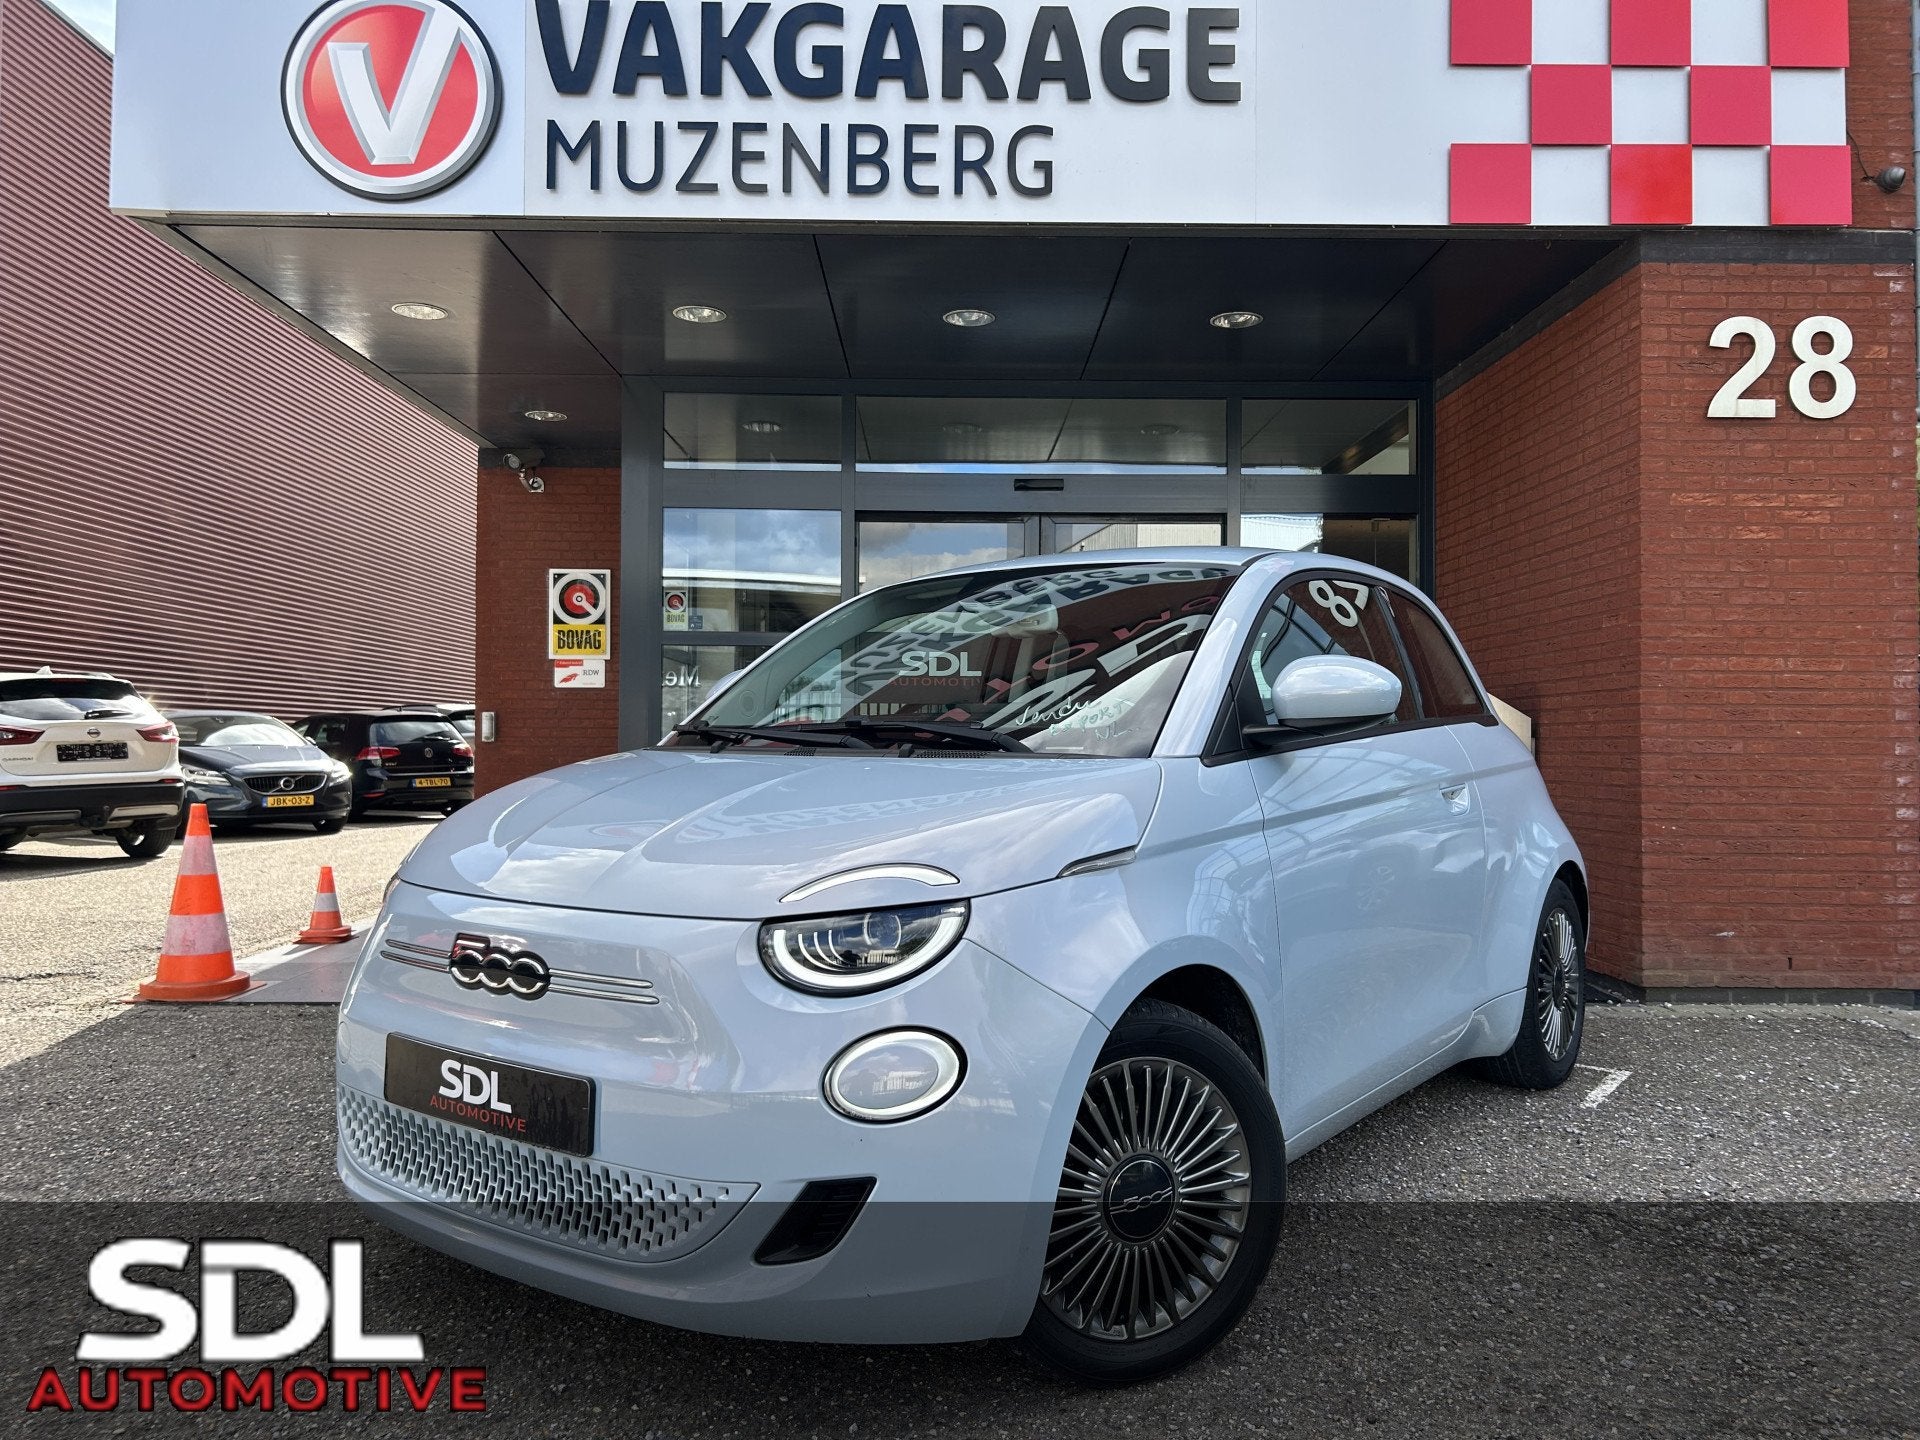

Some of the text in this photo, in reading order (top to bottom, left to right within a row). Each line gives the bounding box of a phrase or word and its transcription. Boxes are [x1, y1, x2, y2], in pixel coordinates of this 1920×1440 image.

[534, 0, 1242, 102] VAKGARAGE
[545, 118, 1055, 198] MUZENBERG
[1707, 315, 1857, 419] 28
[557, 629, 602, 650] BOVAG
[666, 613, 686, 623] BOVAG
[898, 650, 982, 676] SDL
[270, 796, 311, 806] JBK-03-Z
[450, 932, 550, 1000] 500
[439, 1059, 513, 1114] SDL
[429, 1093, 527, 1134] AUTOMOTIVE
